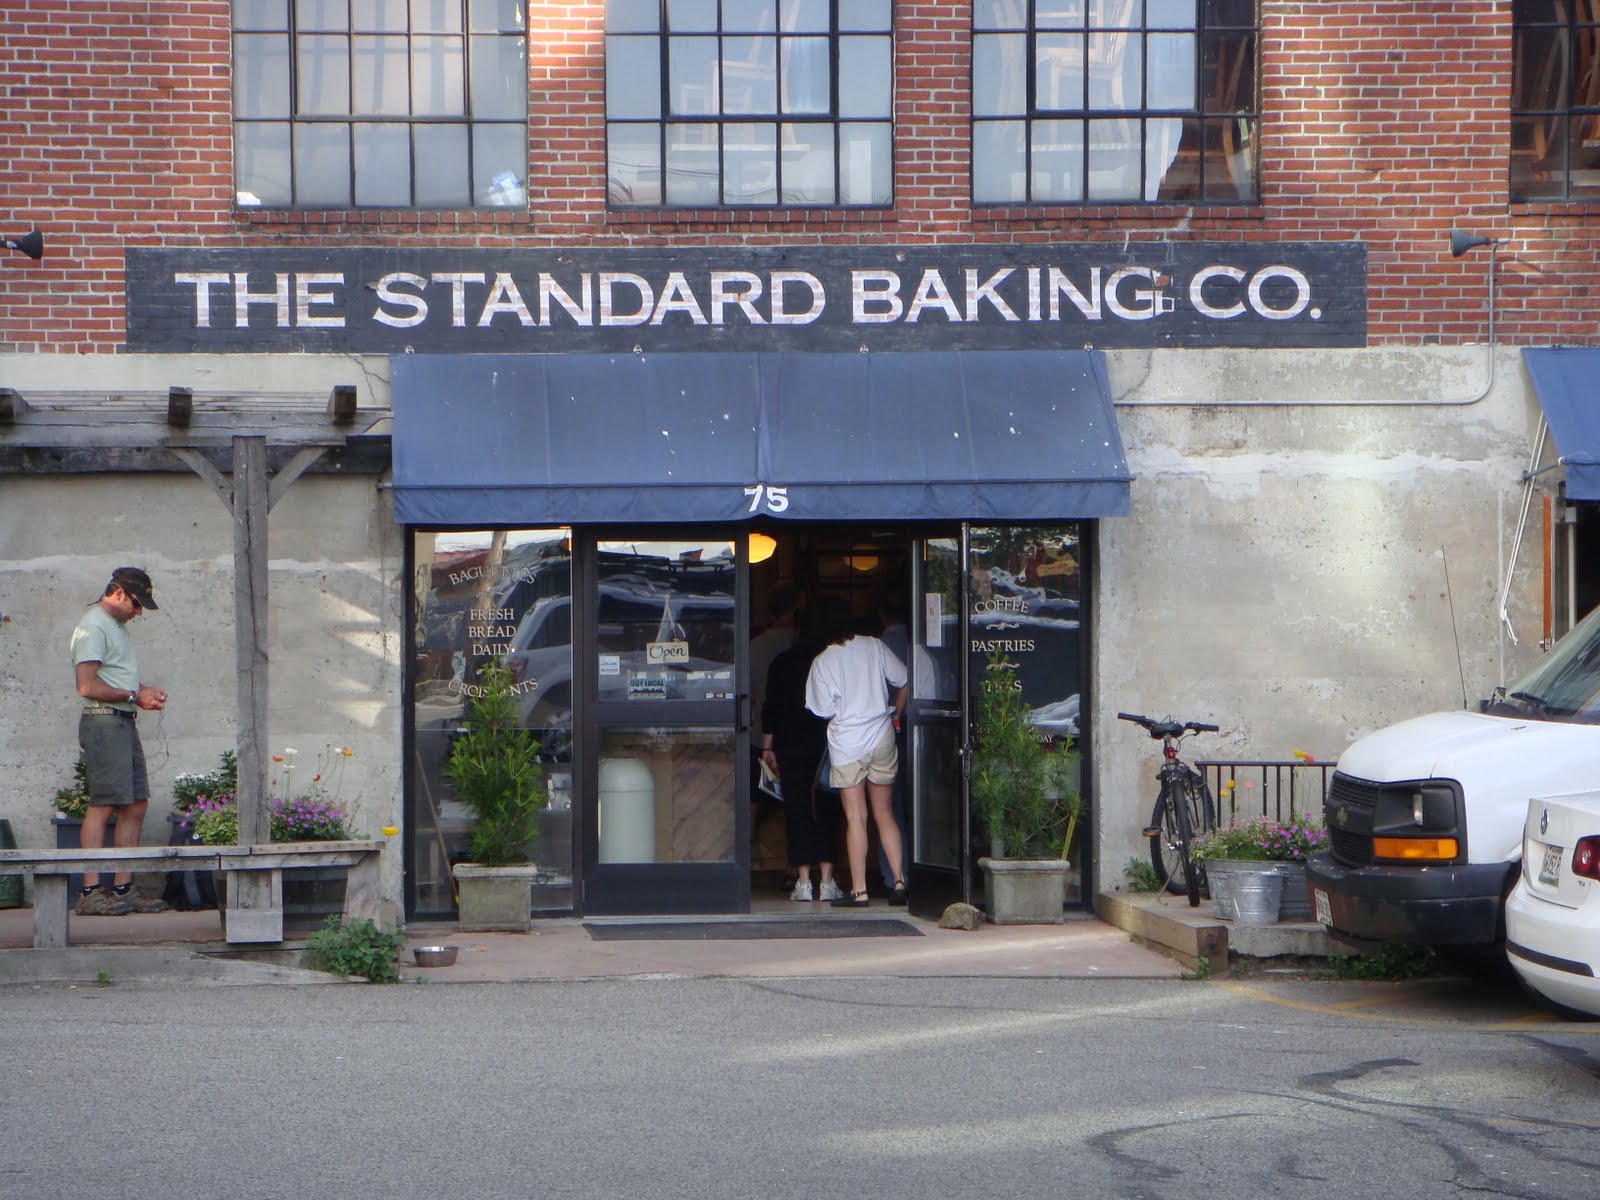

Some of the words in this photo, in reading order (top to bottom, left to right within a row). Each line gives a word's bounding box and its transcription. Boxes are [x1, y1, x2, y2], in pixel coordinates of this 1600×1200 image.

[174, 271, 347, 329] THE
[372, 270, 827, 329] STANDARD
[851, 265, 1164, 325] BAKING
[1189, 265, 1322, 321] CO.
[744, 484, 789, 513] 75
[974, 599, 1030, 614] COFFEE
[469, 608, 515, 621] FRESH
[468, 625, 518, 638] BREAD
[472, 643, 513, 656] DAILY
[971, 639, 1035, 652] PASTRIES
[649, 645, 687, 662] Open
[630, 679, 644, 687] BUY
[644, 679, 665, 687] LOCAL
[985, 679, 1023, 692] TS
